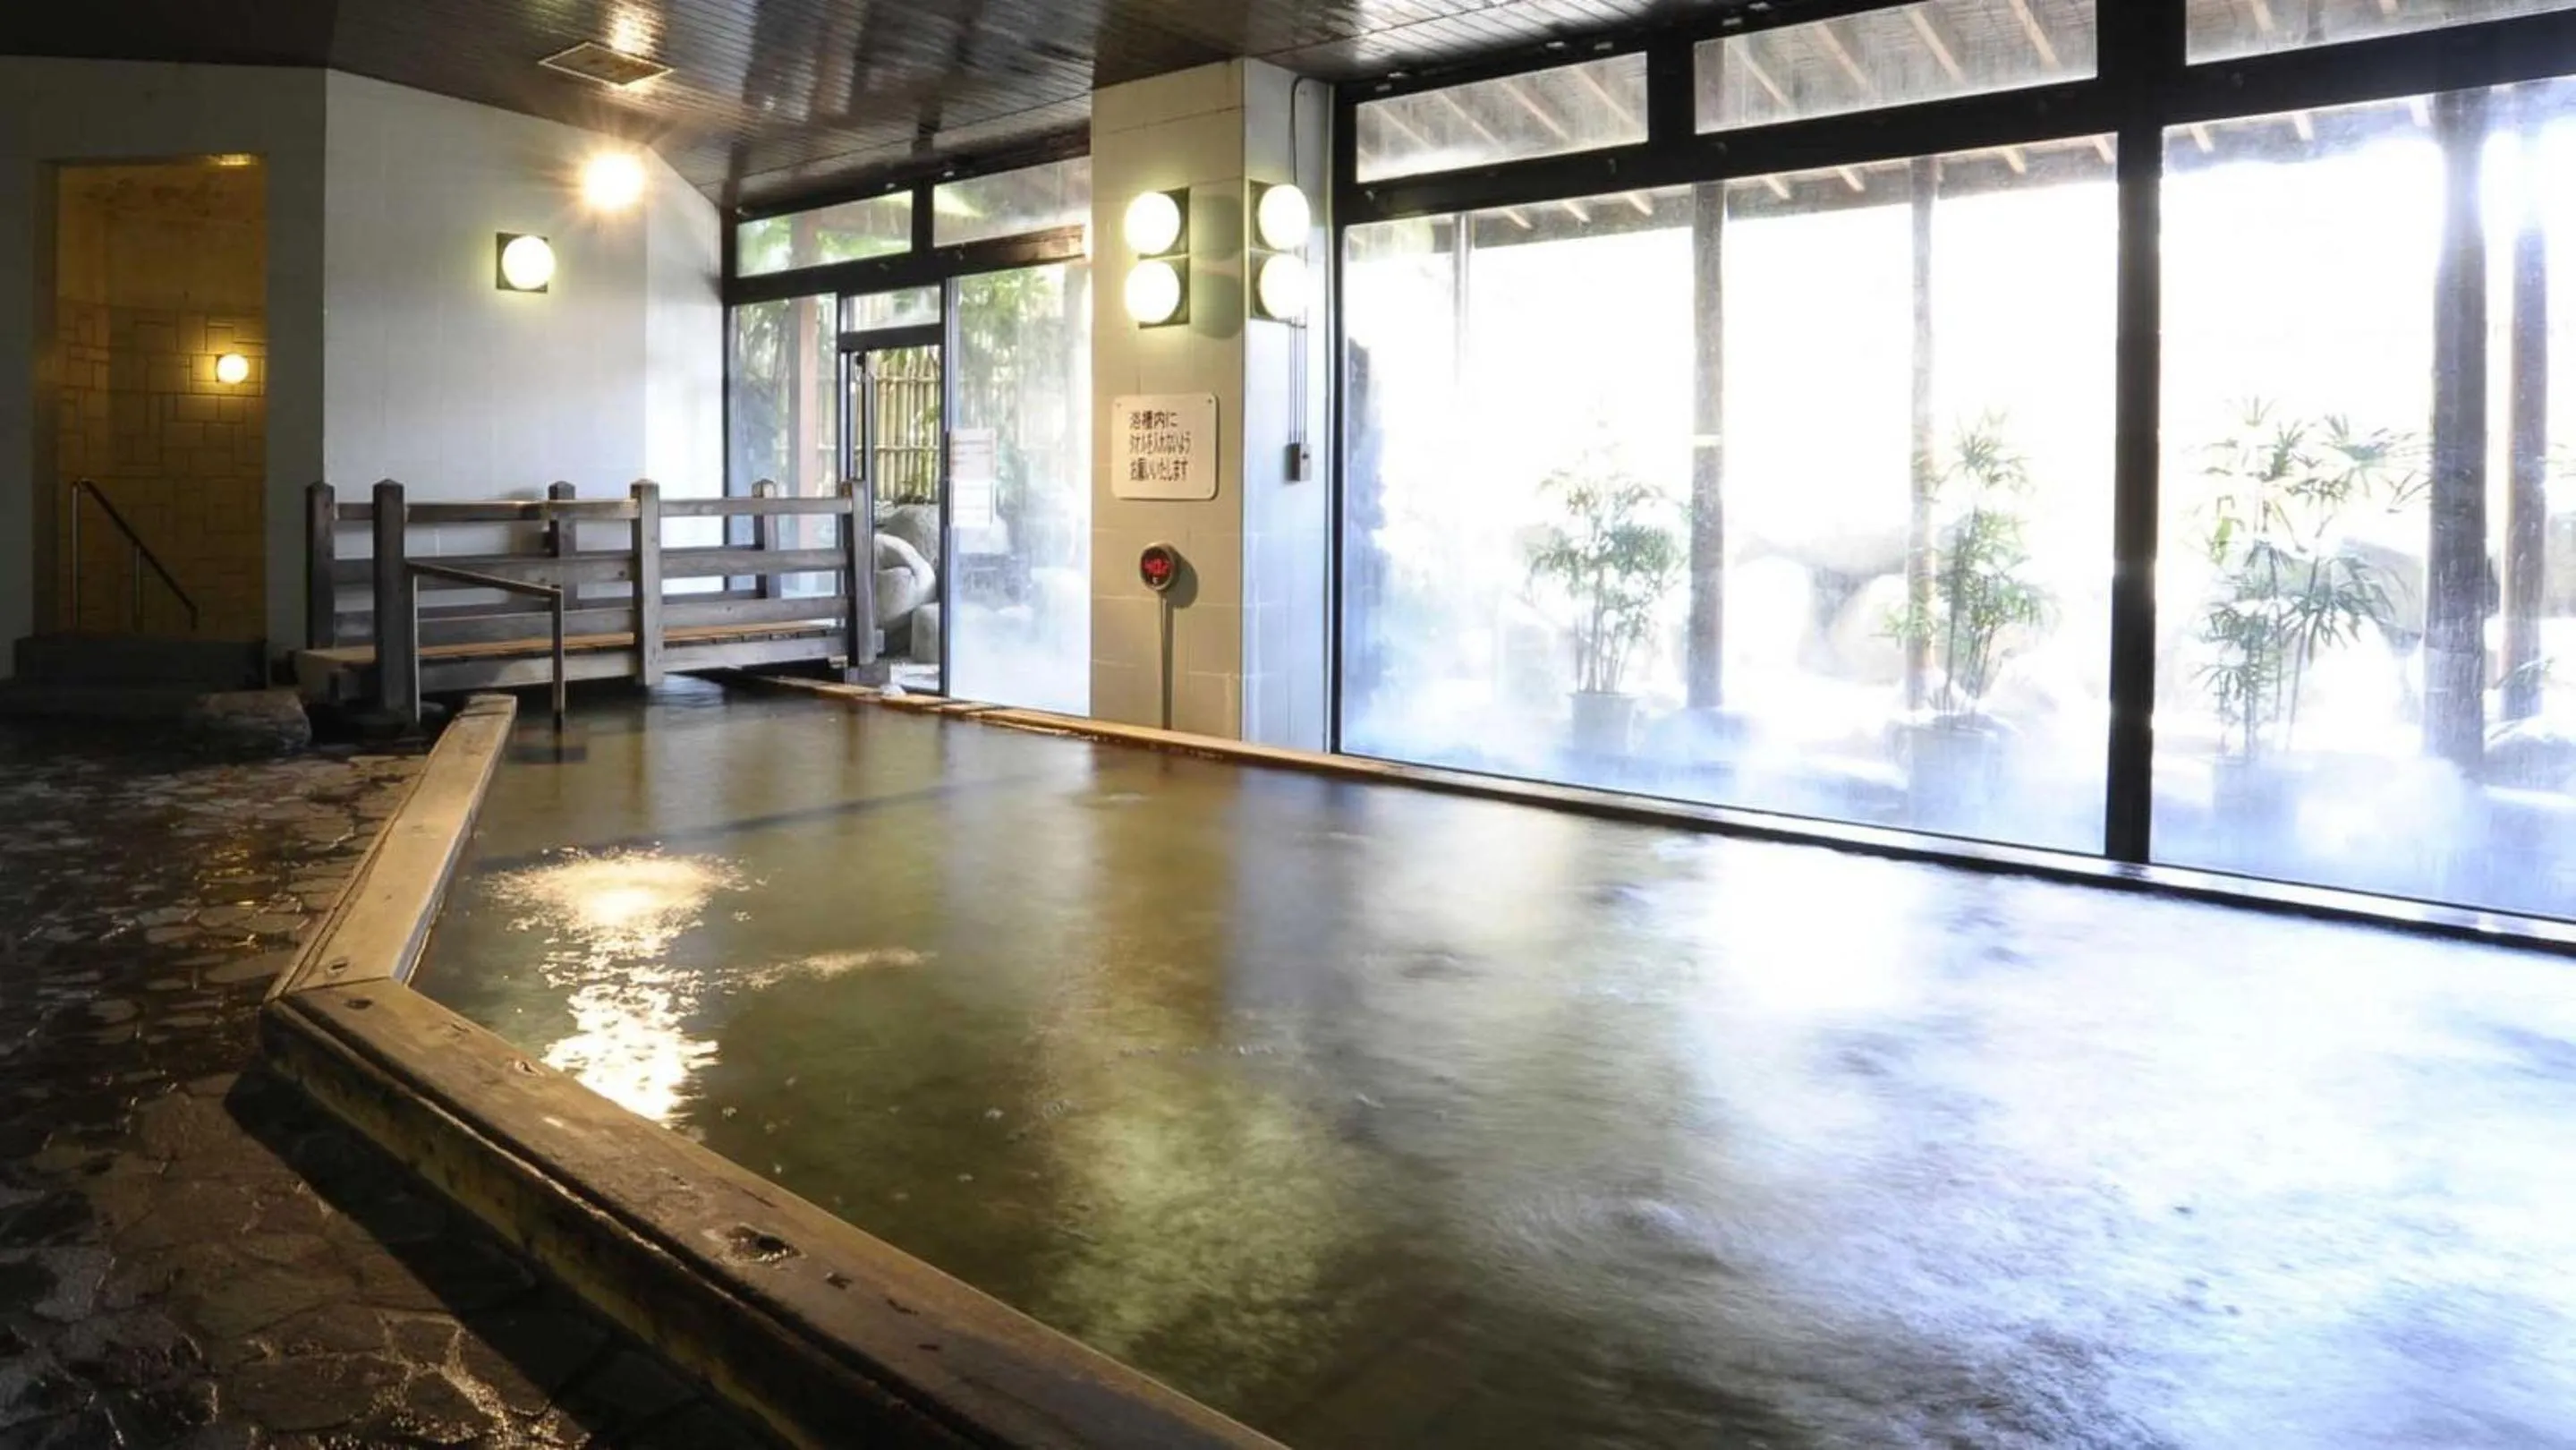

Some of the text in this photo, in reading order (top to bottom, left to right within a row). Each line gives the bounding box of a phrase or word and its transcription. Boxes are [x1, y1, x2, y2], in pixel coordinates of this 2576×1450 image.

[1129, 410, 1177, 430] 浴槽内に
[1129, 457, 1188, 481] お願いいたします
